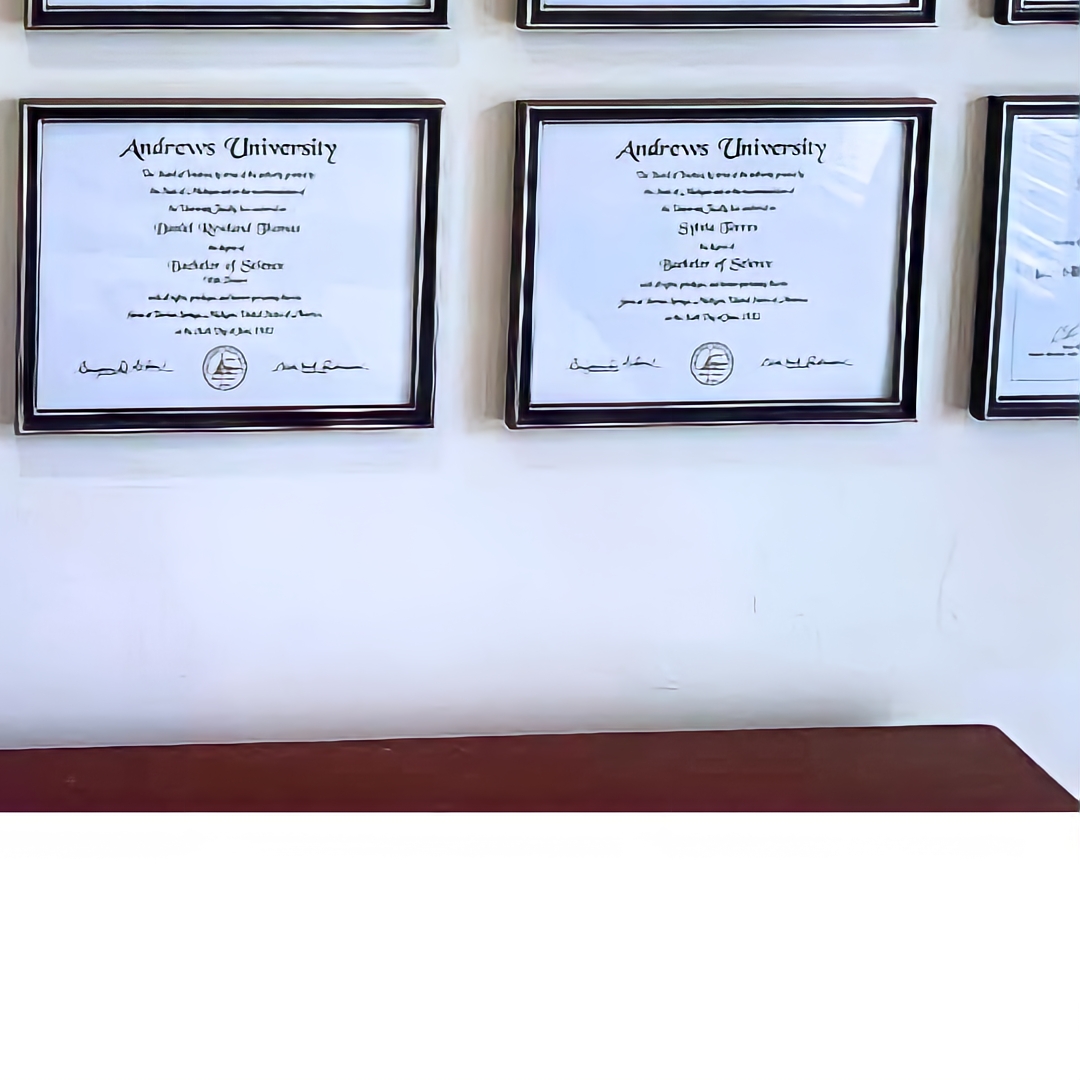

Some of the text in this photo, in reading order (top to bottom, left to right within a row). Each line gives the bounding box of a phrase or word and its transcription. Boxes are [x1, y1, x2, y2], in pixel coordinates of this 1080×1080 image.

[119, 137, 336, 164] Andrews University
[616, 138, 826, 163] Andrews University
